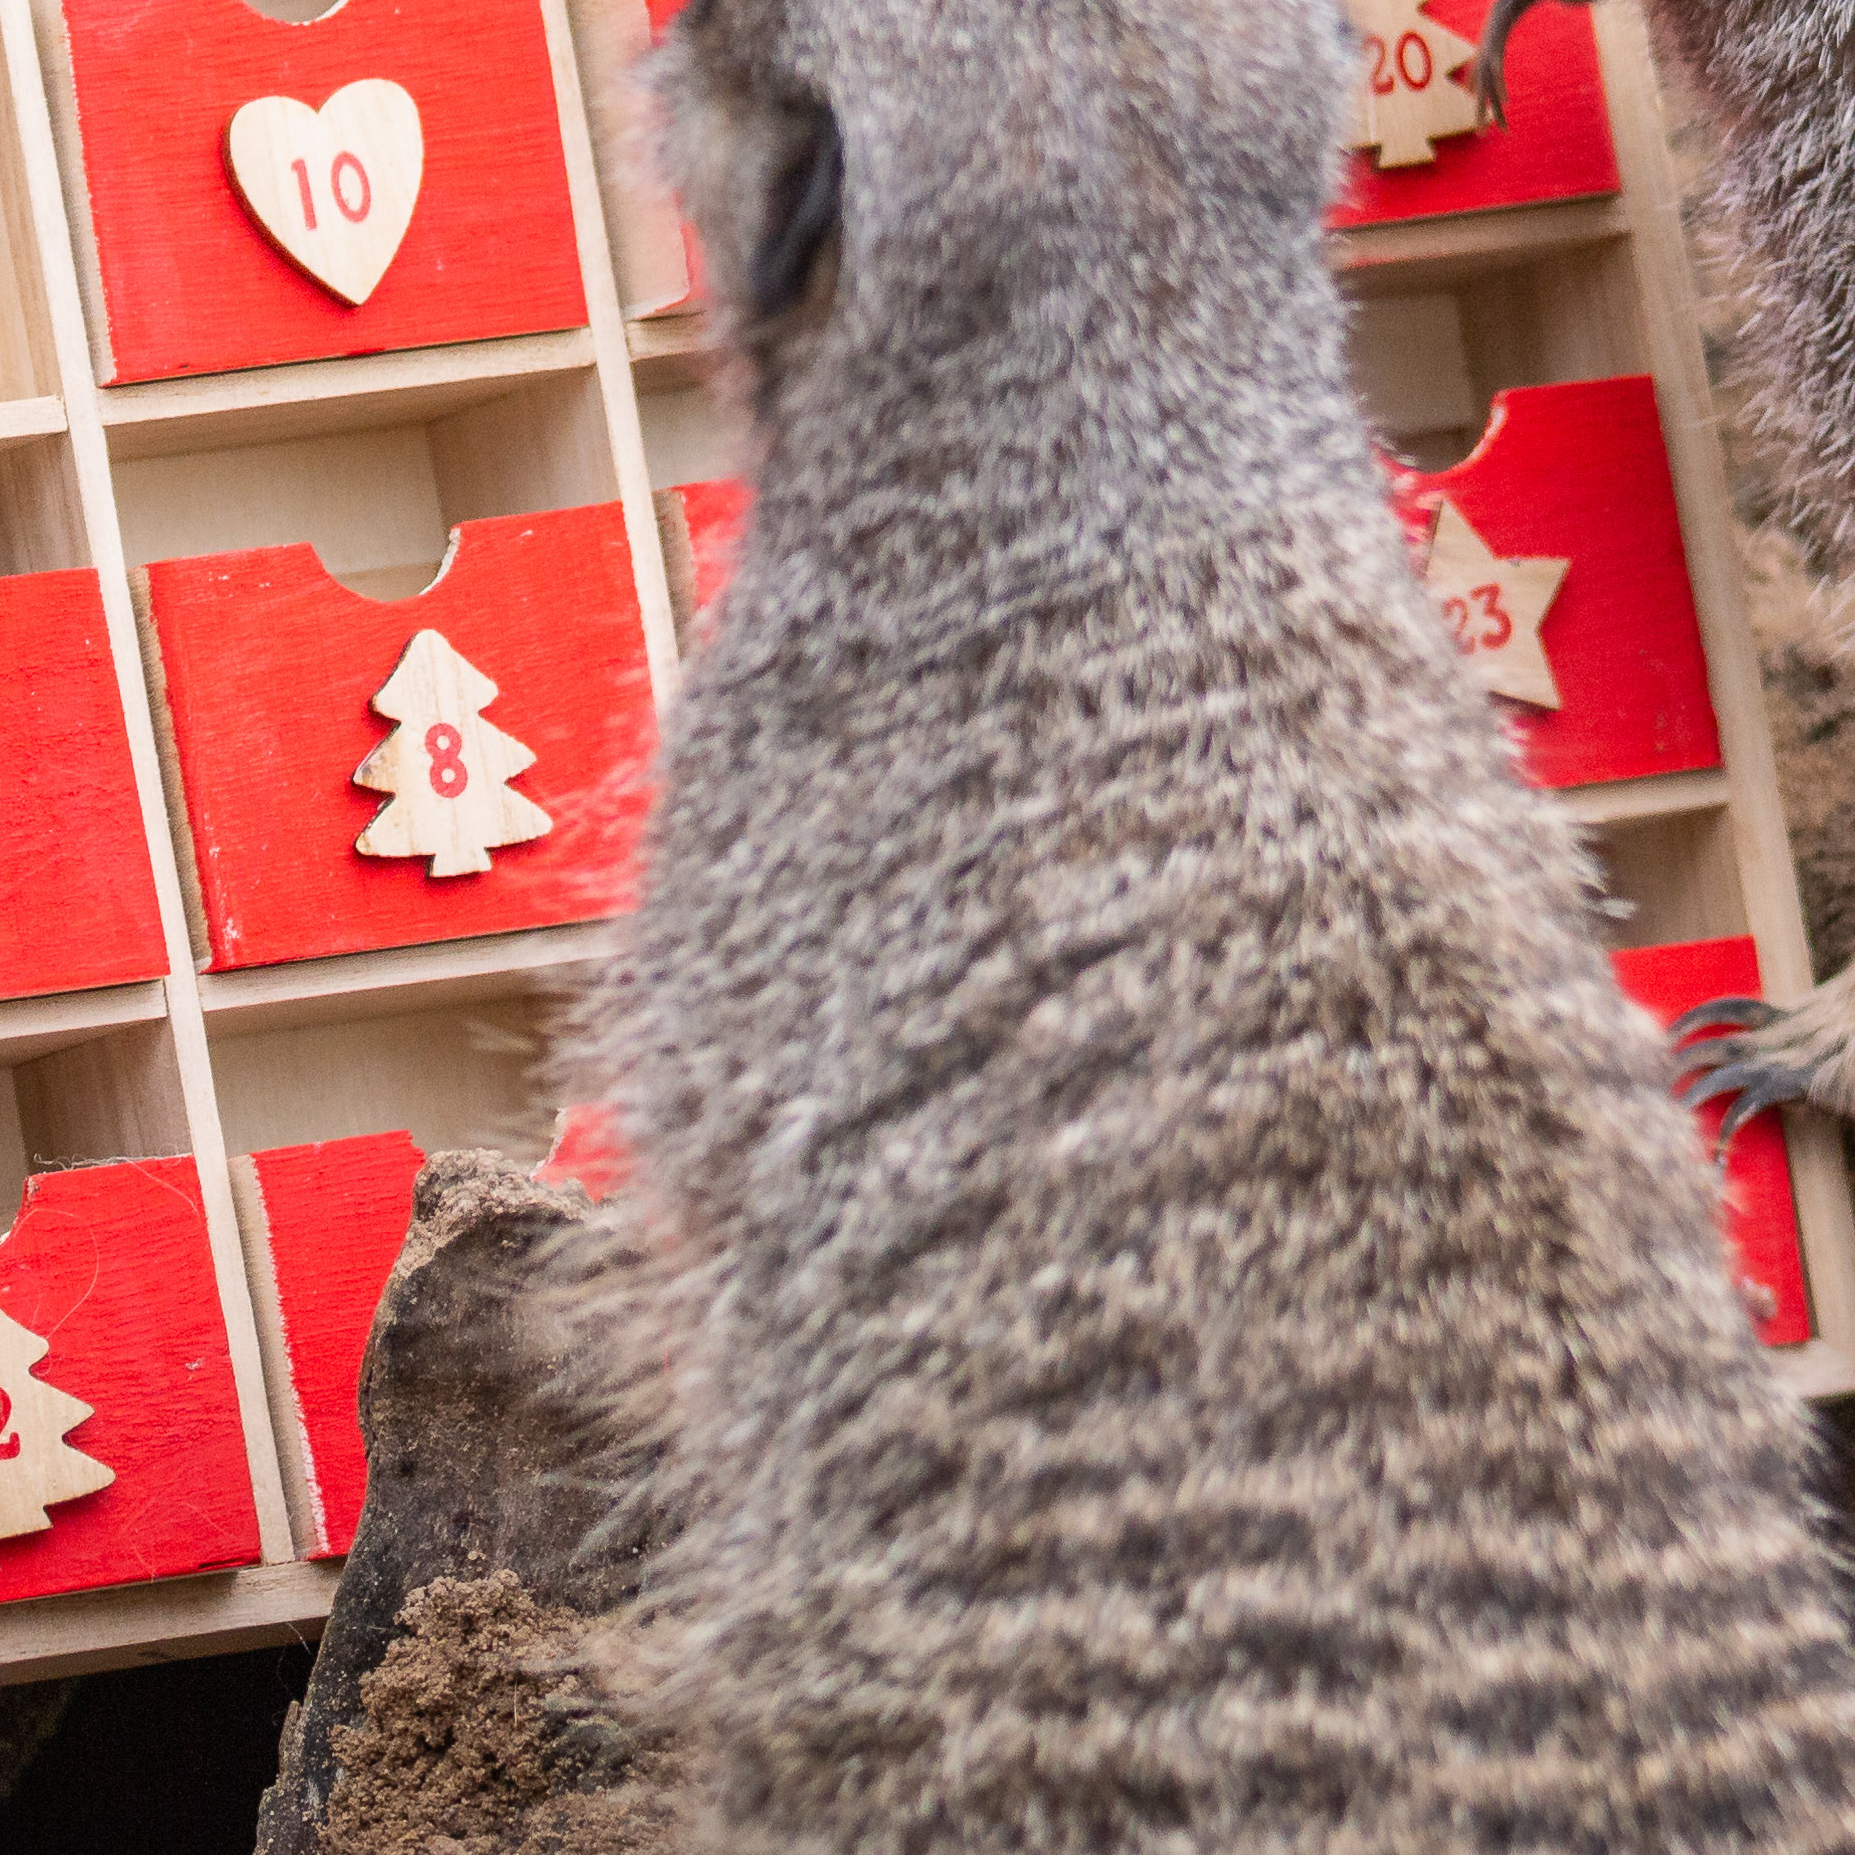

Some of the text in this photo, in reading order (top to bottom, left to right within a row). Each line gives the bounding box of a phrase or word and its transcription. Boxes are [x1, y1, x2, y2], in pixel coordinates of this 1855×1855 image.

[1364, 31, 1432, 95] 20
[291, 151, 371, 230] 10
[1441, 582, 1513, 656] 23
[424, 722, 469, 799] 8
